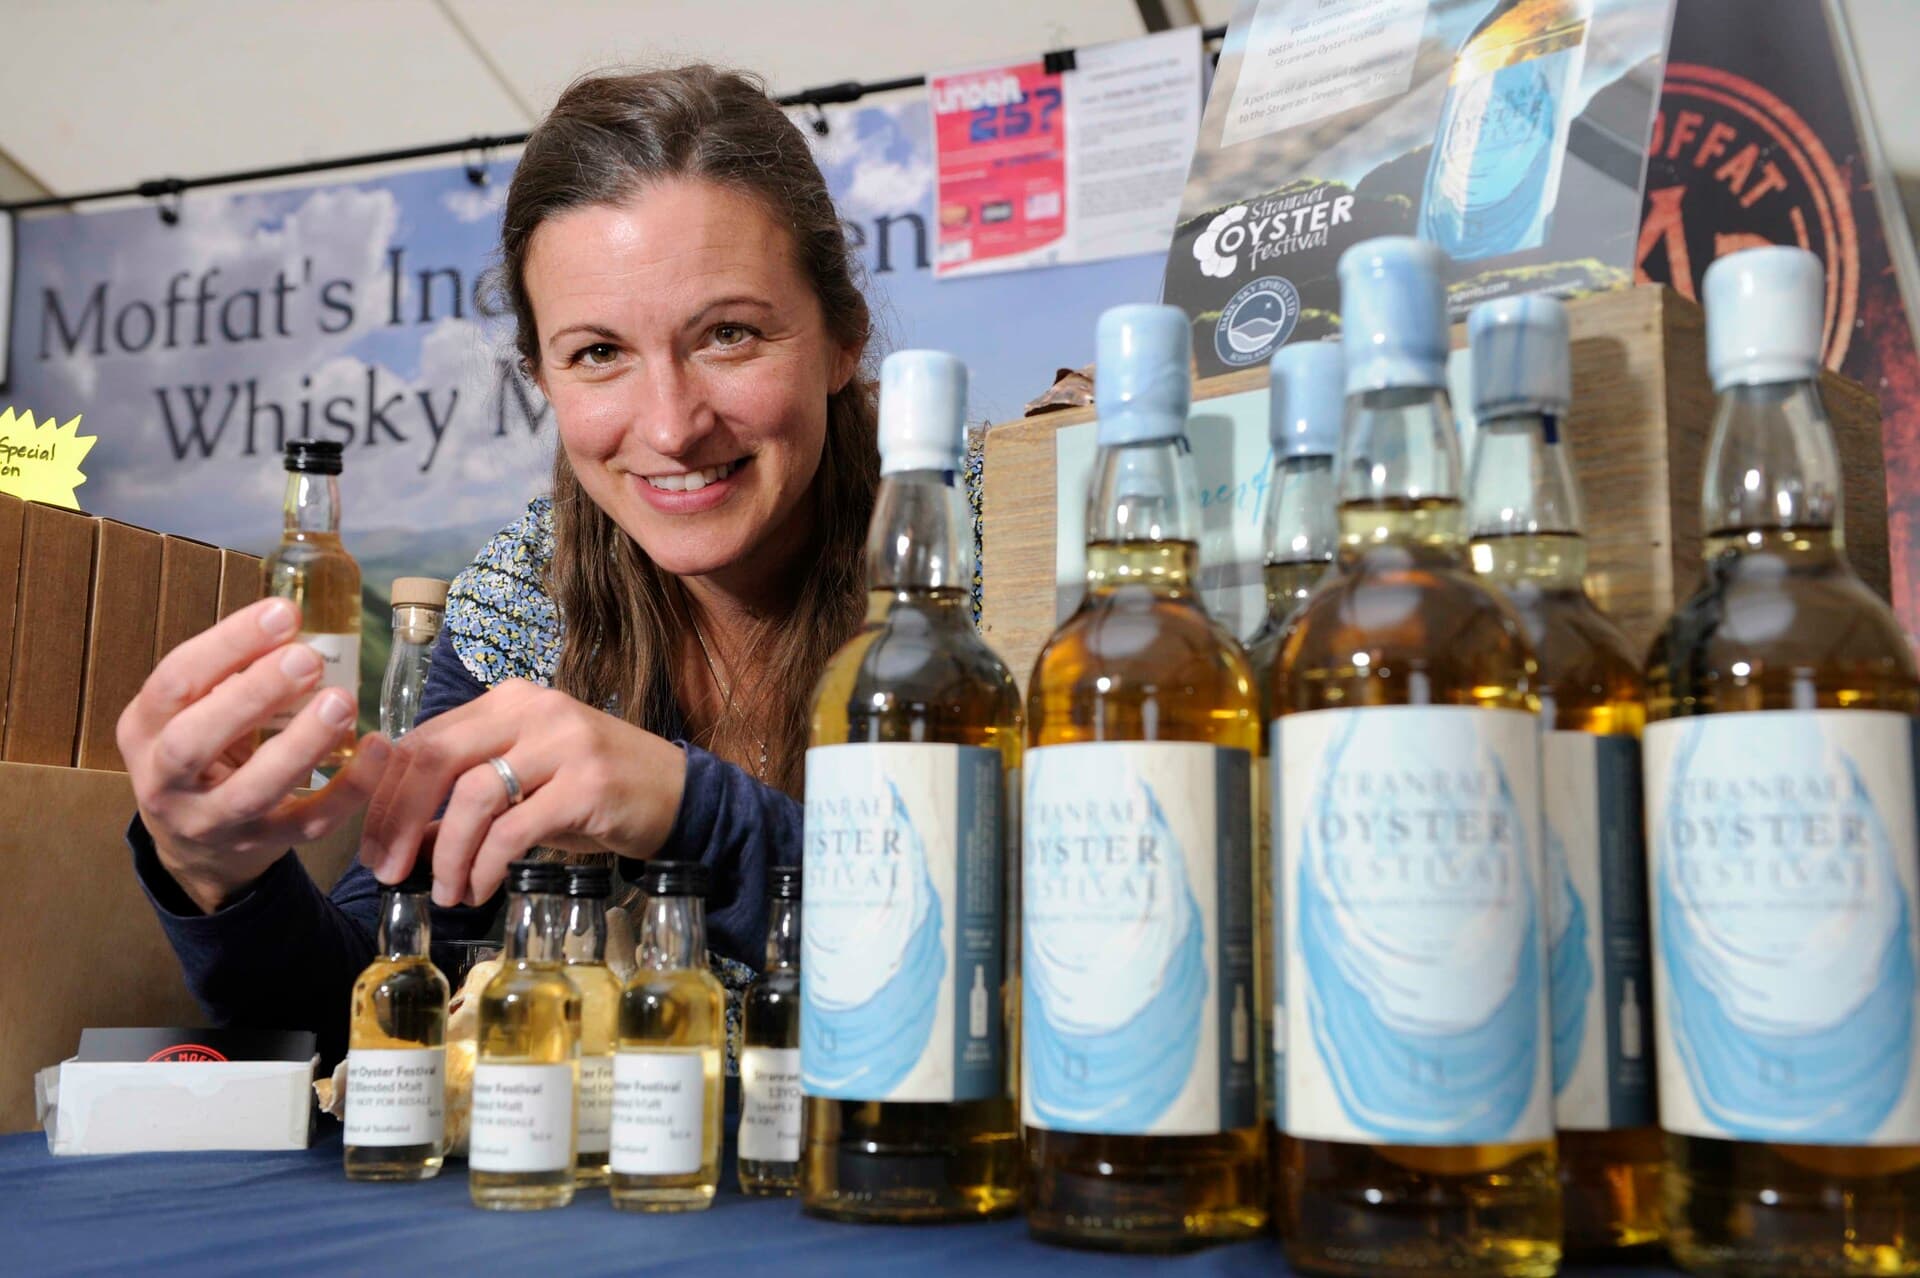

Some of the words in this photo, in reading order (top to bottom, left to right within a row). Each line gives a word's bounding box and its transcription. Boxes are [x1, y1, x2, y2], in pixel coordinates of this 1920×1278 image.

[1250, 187, 1328, 219] Stranraer
[1220, 195, 1355, 253] OYSTER
[37, 258, 355, 361] Moffat's
[1219, 302, 1238, 332] DARK
[1237, 282, 1258, 302] SKY
[1259, 280, 1292, 300] SPIRITS
[156, 365, 458, 472] Whisky
[0, 436, 56, 464] Special
[1317, 809, 1513, 845] OYSTER
[1670, 812, 1871, 848] OYSTER
[359, 1066, 393, 1078] Oyster
[396, 1065, 437, 1077] Festival
[397, 1082, 422, 1092] Malt
[634, 1079, 683, 1094] Festival
[495, 1082, 544, 1096] Festival
